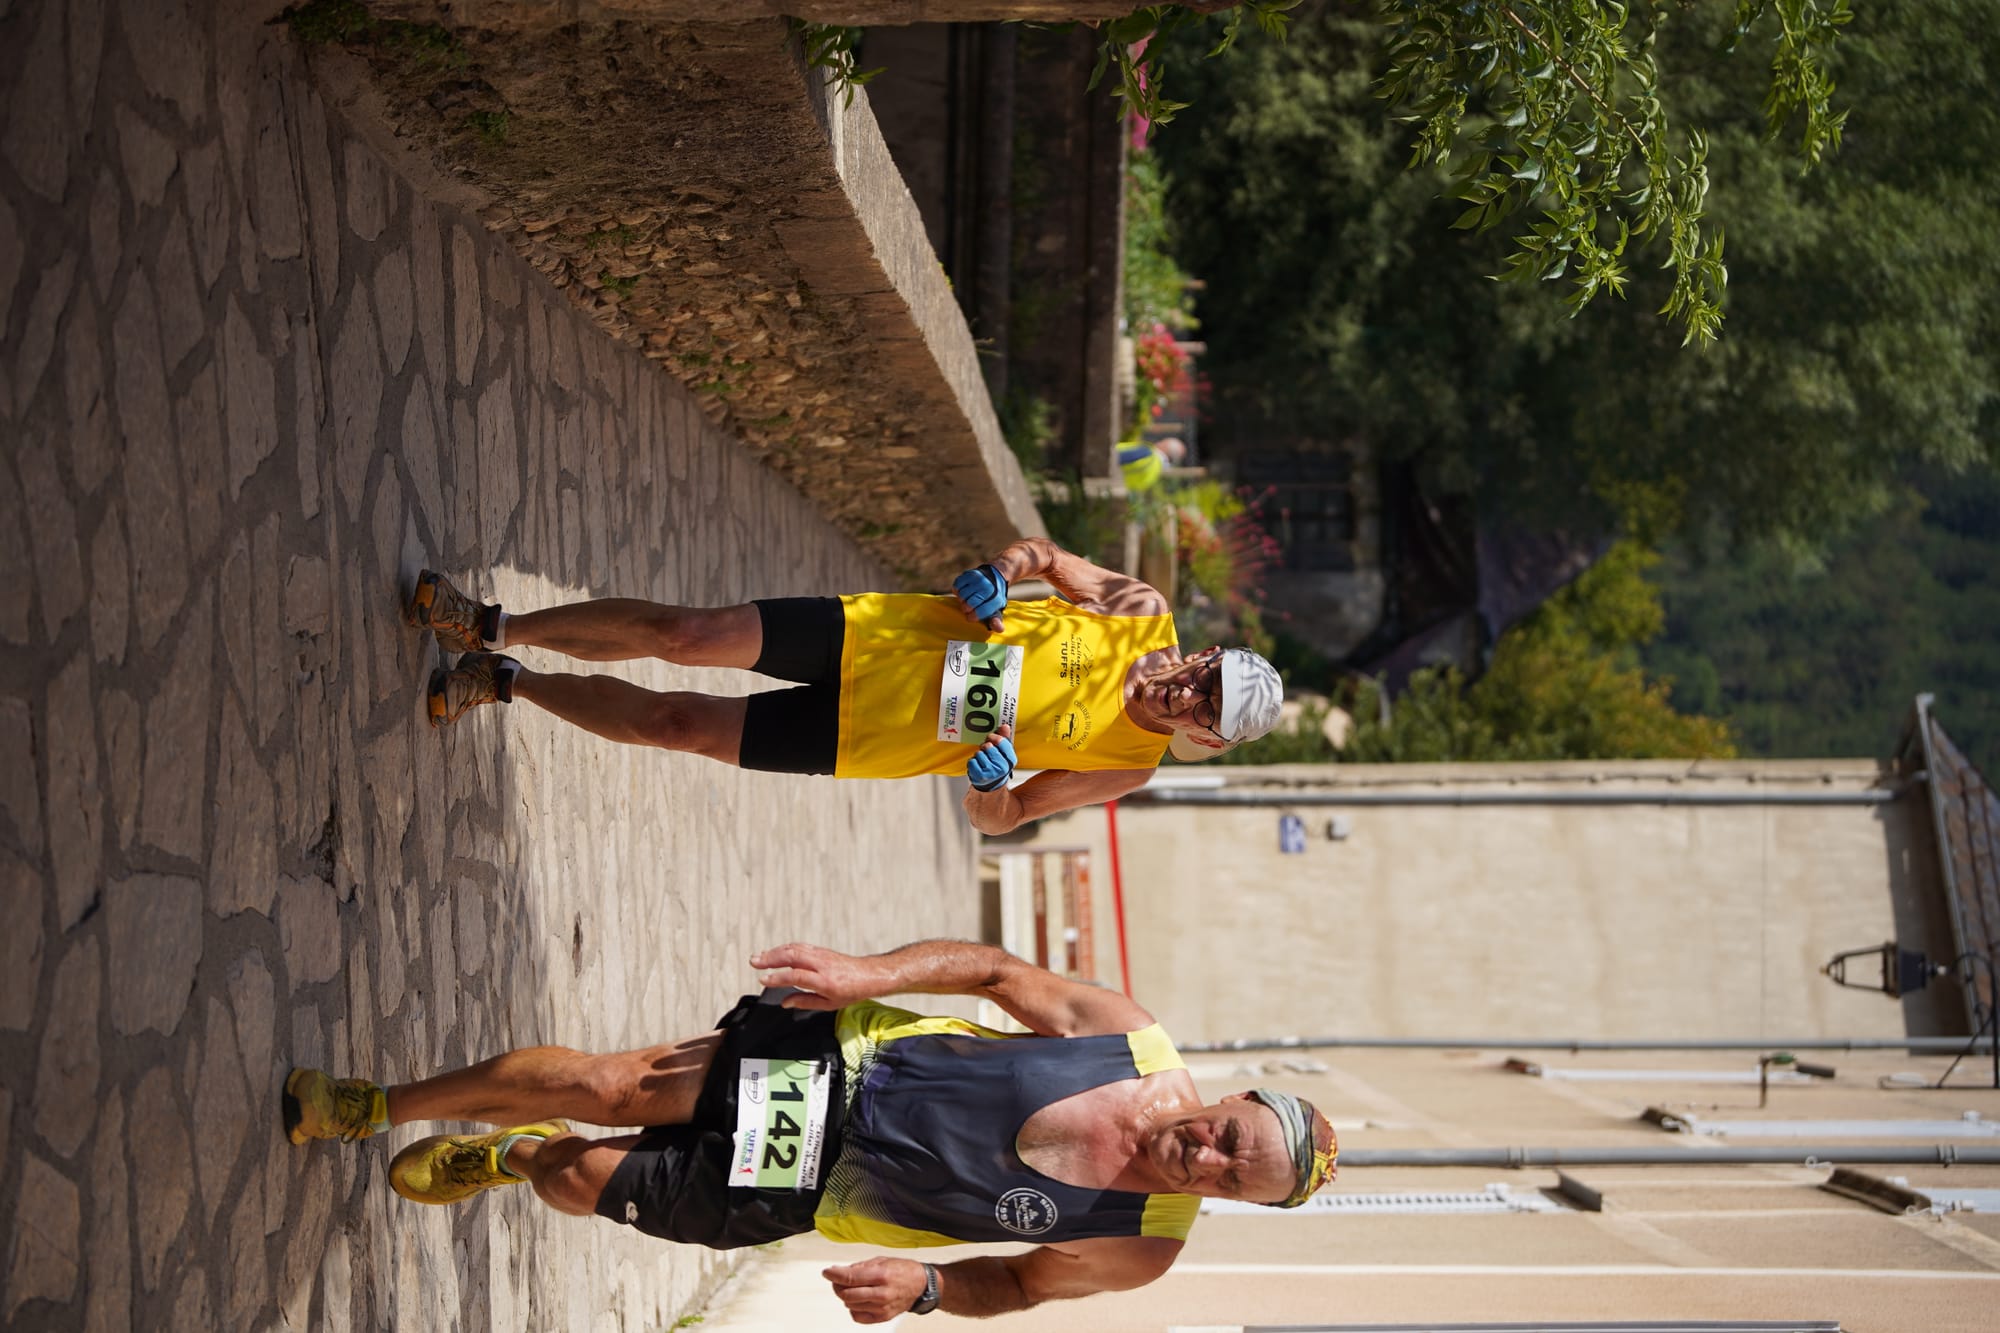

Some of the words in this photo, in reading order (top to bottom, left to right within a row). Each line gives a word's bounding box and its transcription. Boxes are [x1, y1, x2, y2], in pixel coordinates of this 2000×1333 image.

[1060, 641, 1068, 678] TUFF'S
[948, 695, 958, 726] TUFF'S
[965, 660, 1000, 732] 160
[762, 1082, 804, 1169] 142
[744, 1128, 757, 1164] TUFF'S
[1040, 1199, 1053, 1224] SINCE
